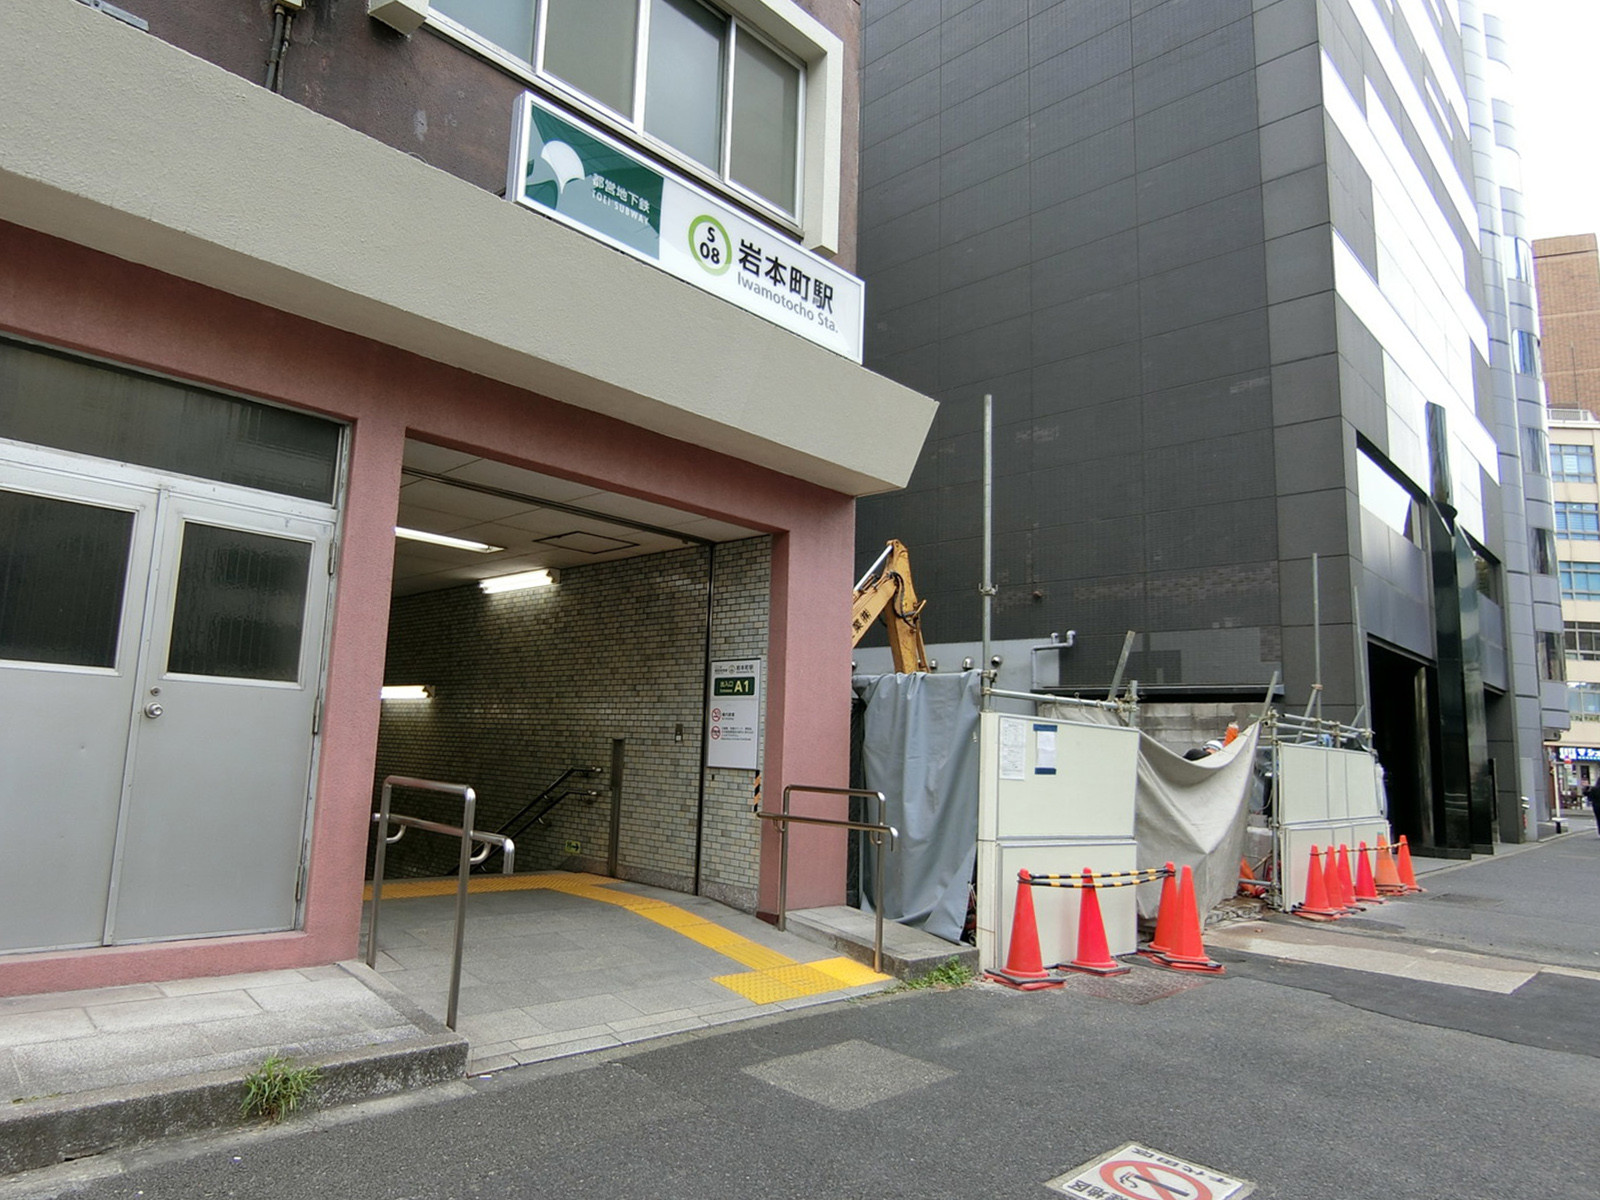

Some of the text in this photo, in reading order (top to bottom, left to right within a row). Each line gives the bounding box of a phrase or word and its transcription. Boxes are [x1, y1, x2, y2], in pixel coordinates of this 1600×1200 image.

[591, 188, 650, 226] TOEI SUBWAY
[592, 172, 651, 214] 都営地下鉄
[699, 241, 721, 265] 08
[706, 226, 716, 243] S
[738, 238, 834, 315] 岩本町駅
[737, 271, 839, 334] Iwamotocho Sta.
[734, 680, 749, 693] A1
